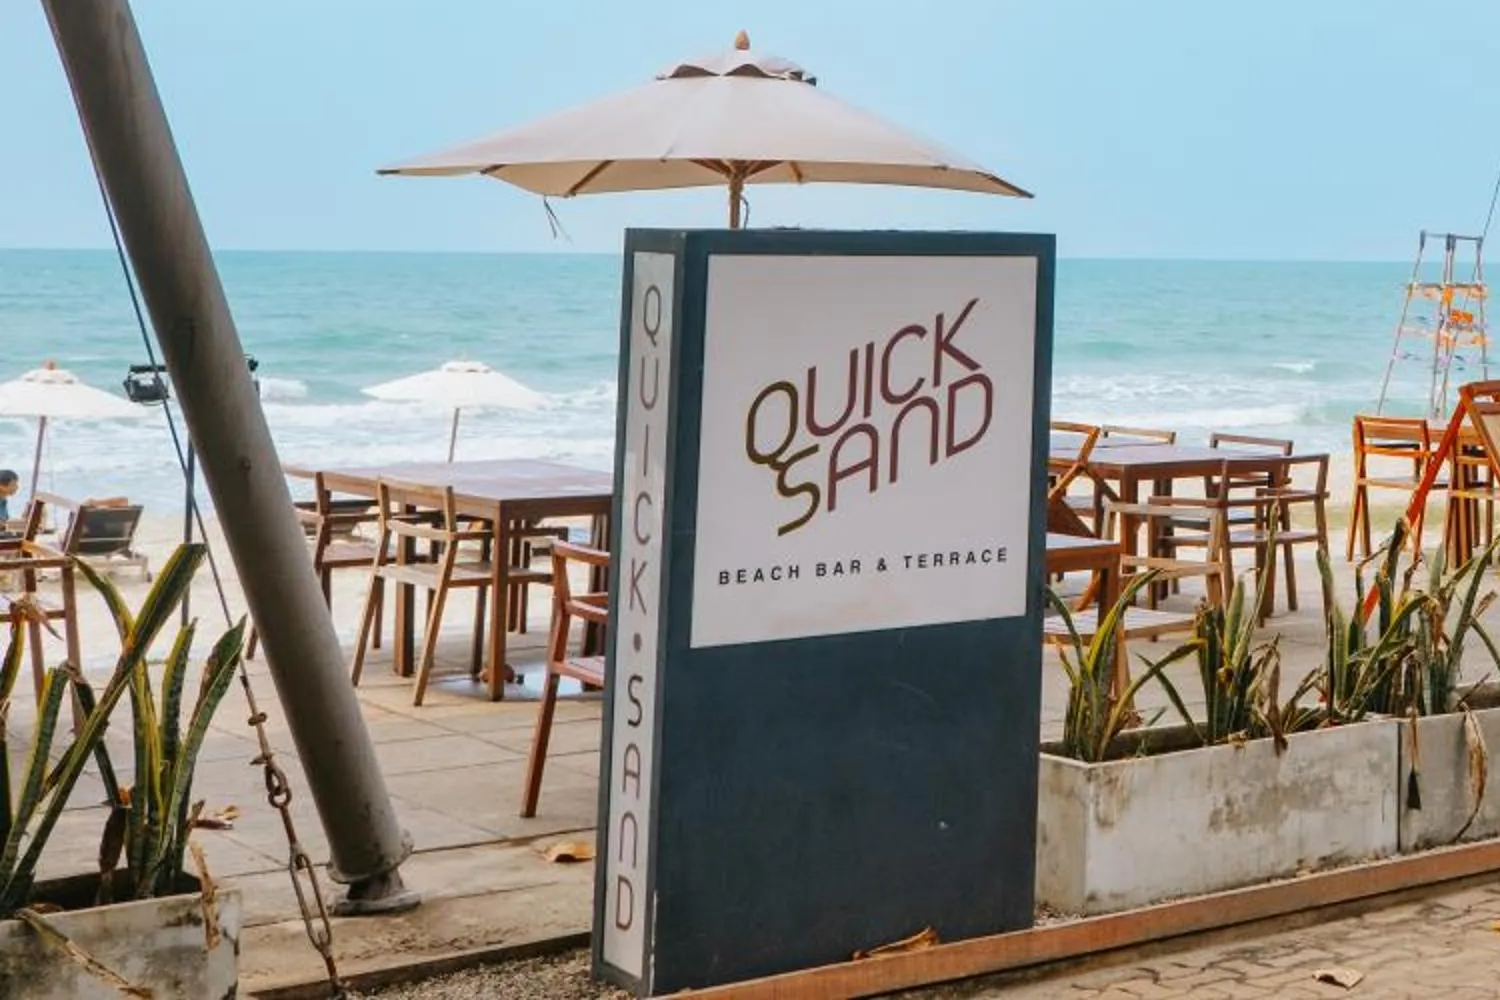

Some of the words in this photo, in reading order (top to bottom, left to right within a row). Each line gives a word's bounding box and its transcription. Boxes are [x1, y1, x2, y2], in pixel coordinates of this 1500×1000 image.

[628, 284, 662, 615] QUICK
[745, 297, 982, 470] QUICK
[776, 372, 994, 537] SAND
[718, 564, 800, 586] BEACH
[815, 559, 862, 577] BAR
[876, 557, 887, 572] &
[903, 547, 1008, 570] TERRACE
[615, 673, 644, 931] SAND
